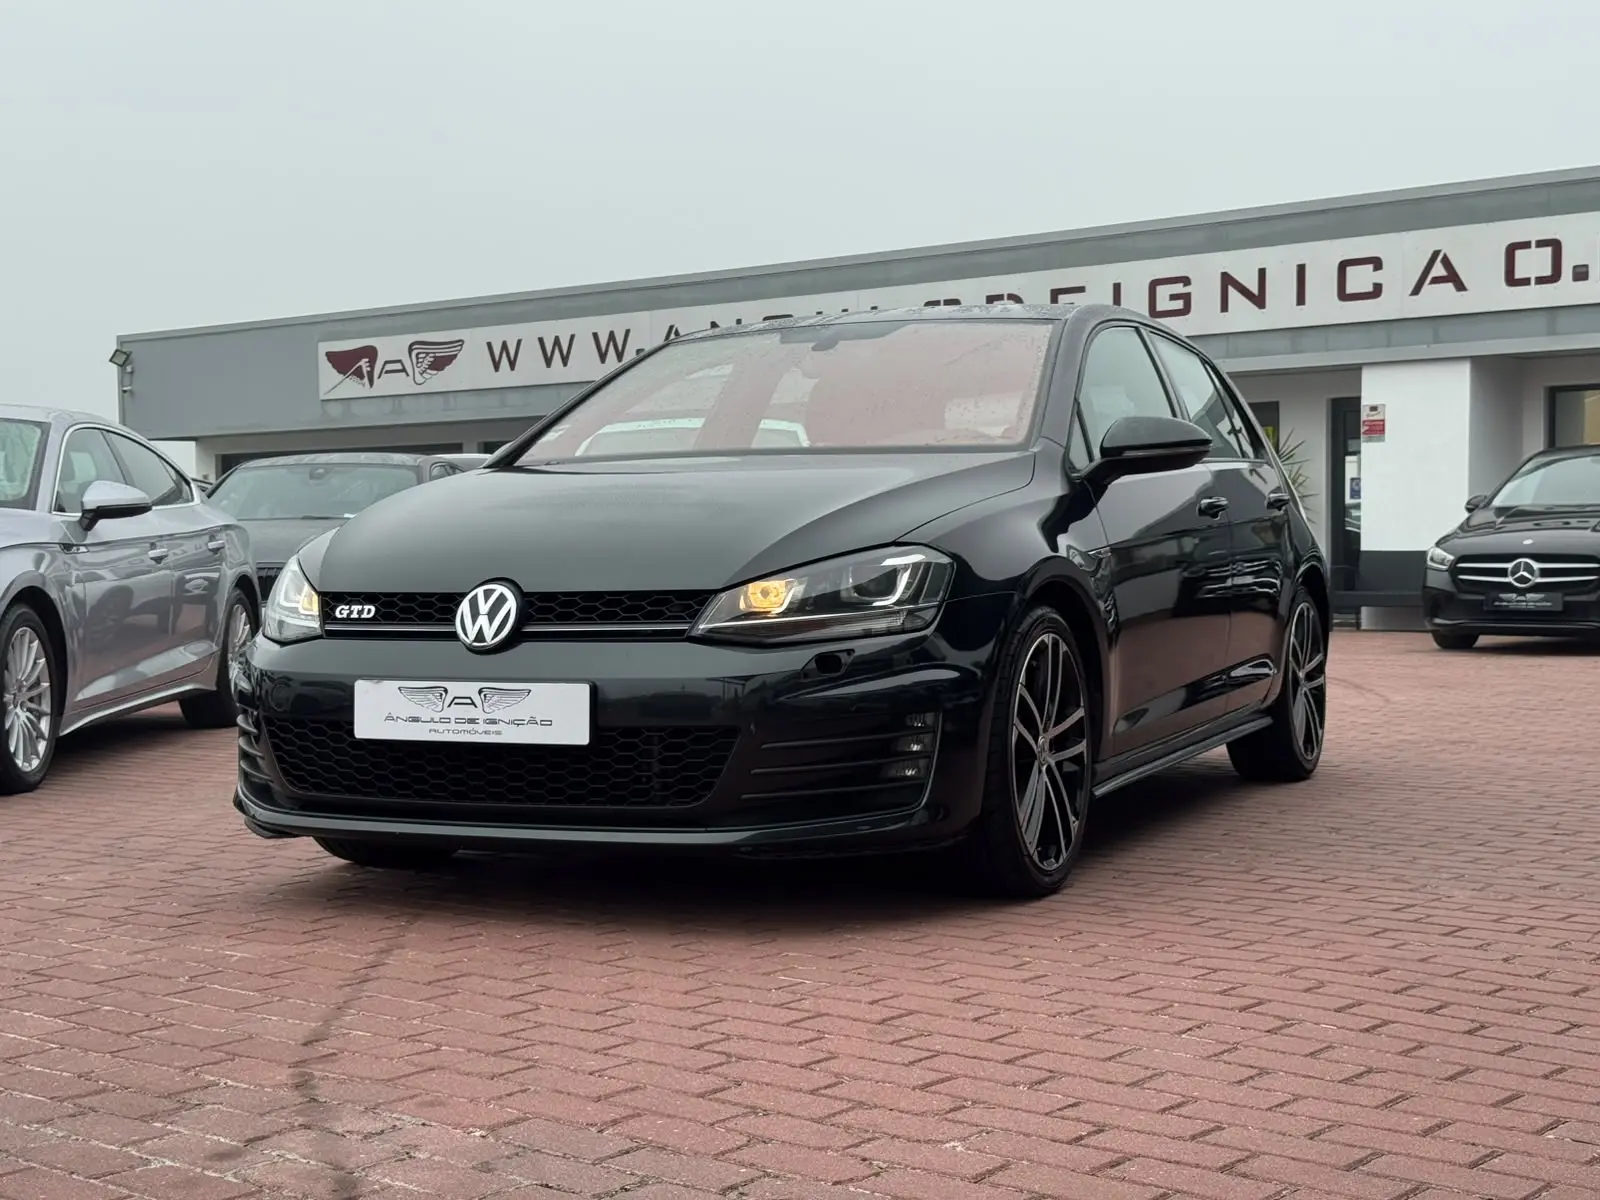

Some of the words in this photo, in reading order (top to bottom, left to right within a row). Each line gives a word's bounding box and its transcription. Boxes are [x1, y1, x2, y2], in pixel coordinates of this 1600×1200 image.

[335, 604, 376, 619] GTD
[455, 583, 517, 647] VW
[384, 712, 451, 724] ÂNGULO
[454, 717, 480, 725] DE
[483, 716, 553, 727] IGNIÇÃO
[428, 727, 503, 736] AUTOMÓVEIS
